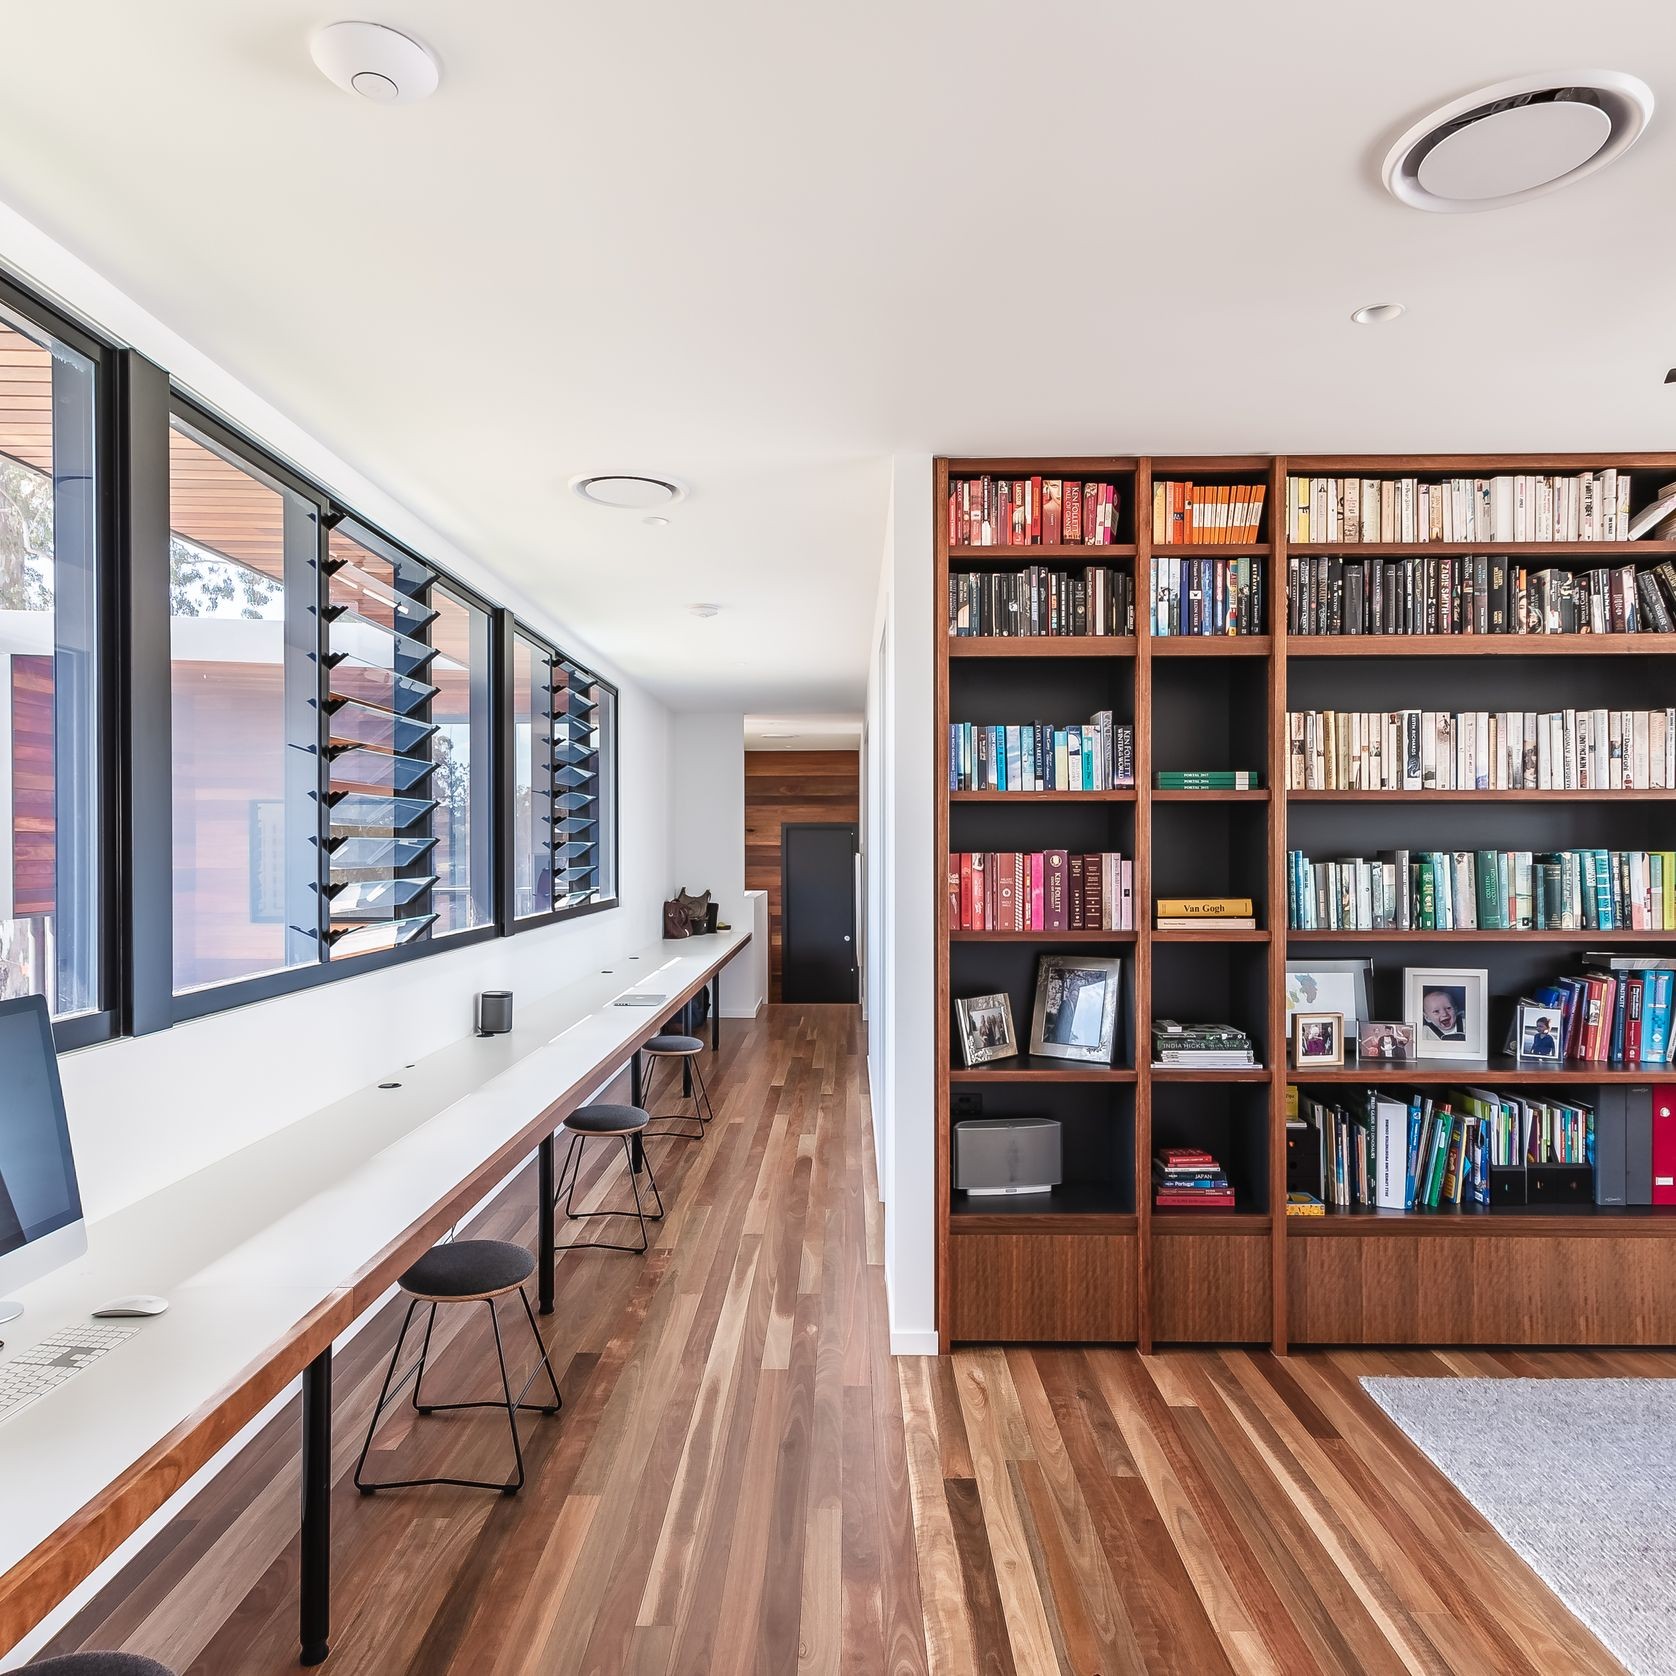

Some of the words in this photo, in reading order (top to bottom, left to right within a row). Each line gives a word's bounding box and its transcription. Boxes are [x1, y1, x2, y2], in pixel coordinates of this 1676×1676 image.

[1072, 487, 1080, 502] KEN
[1072, 502, 1080, 533] FOLLETT
[1441, 563, 1449, 587] ZADIE
[1441, 588, 1449, 614] SMITH
[1183, 904, 1200, 914] Van
[1202, 904, 1225, 914] Gogh
